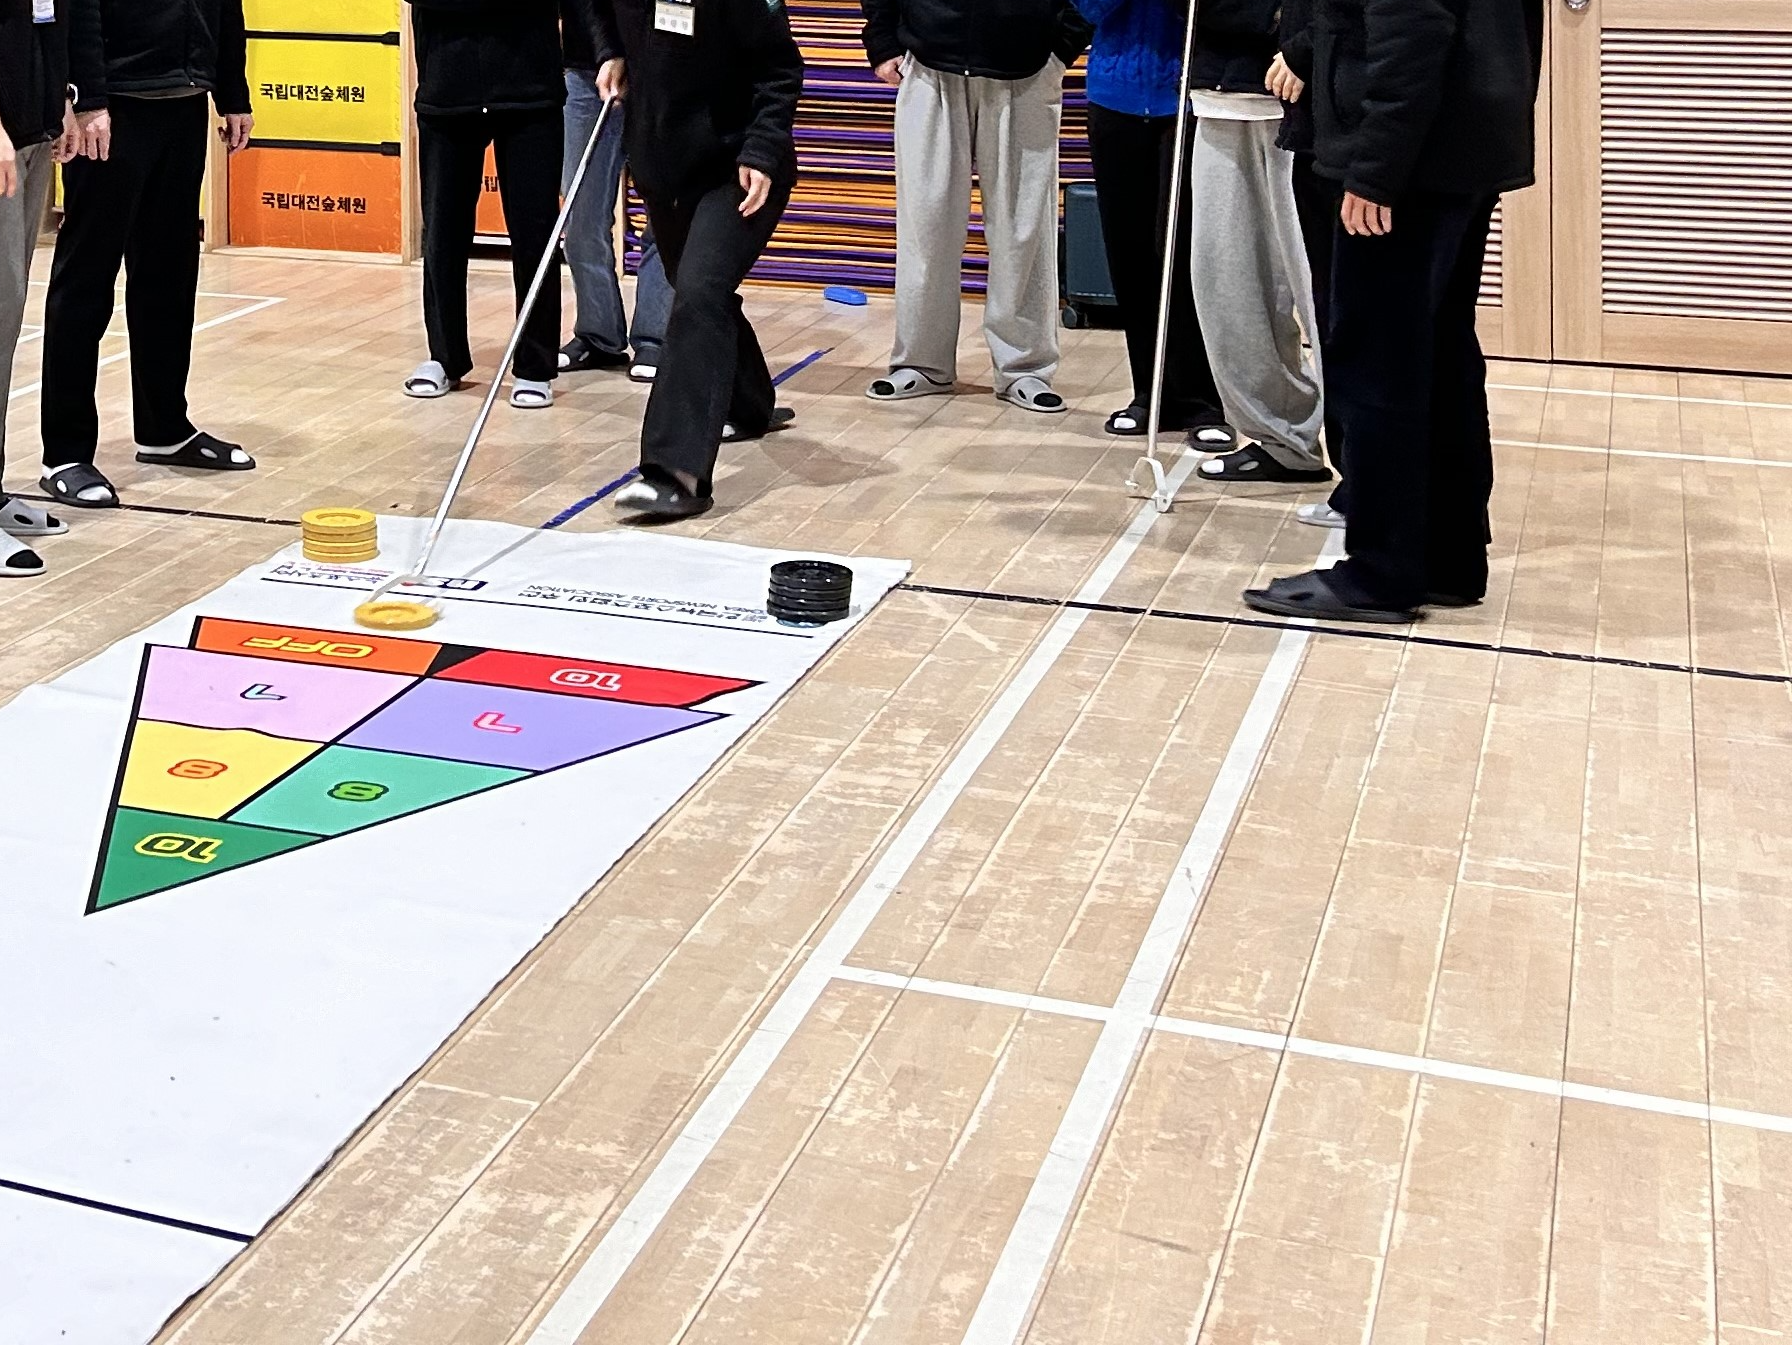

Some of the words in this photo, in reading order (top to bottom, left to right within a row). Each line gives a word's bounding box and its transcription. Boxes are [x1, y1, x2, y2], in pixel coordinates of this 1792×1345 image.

[259, 83, 365, 102] 국립대전숲체원
[261, 192, 366, 214] 국립대전숲체원
[242, 635, 375, 659] OFF
[549, 668, 623, 692] 10
[239, 683, 288, 701] 7
[472, 711, 523, 734] 7
[167, 759, 229, 779] 8
[326, 780, 390, 802] 8
[134, 832, 224, 863] 10
